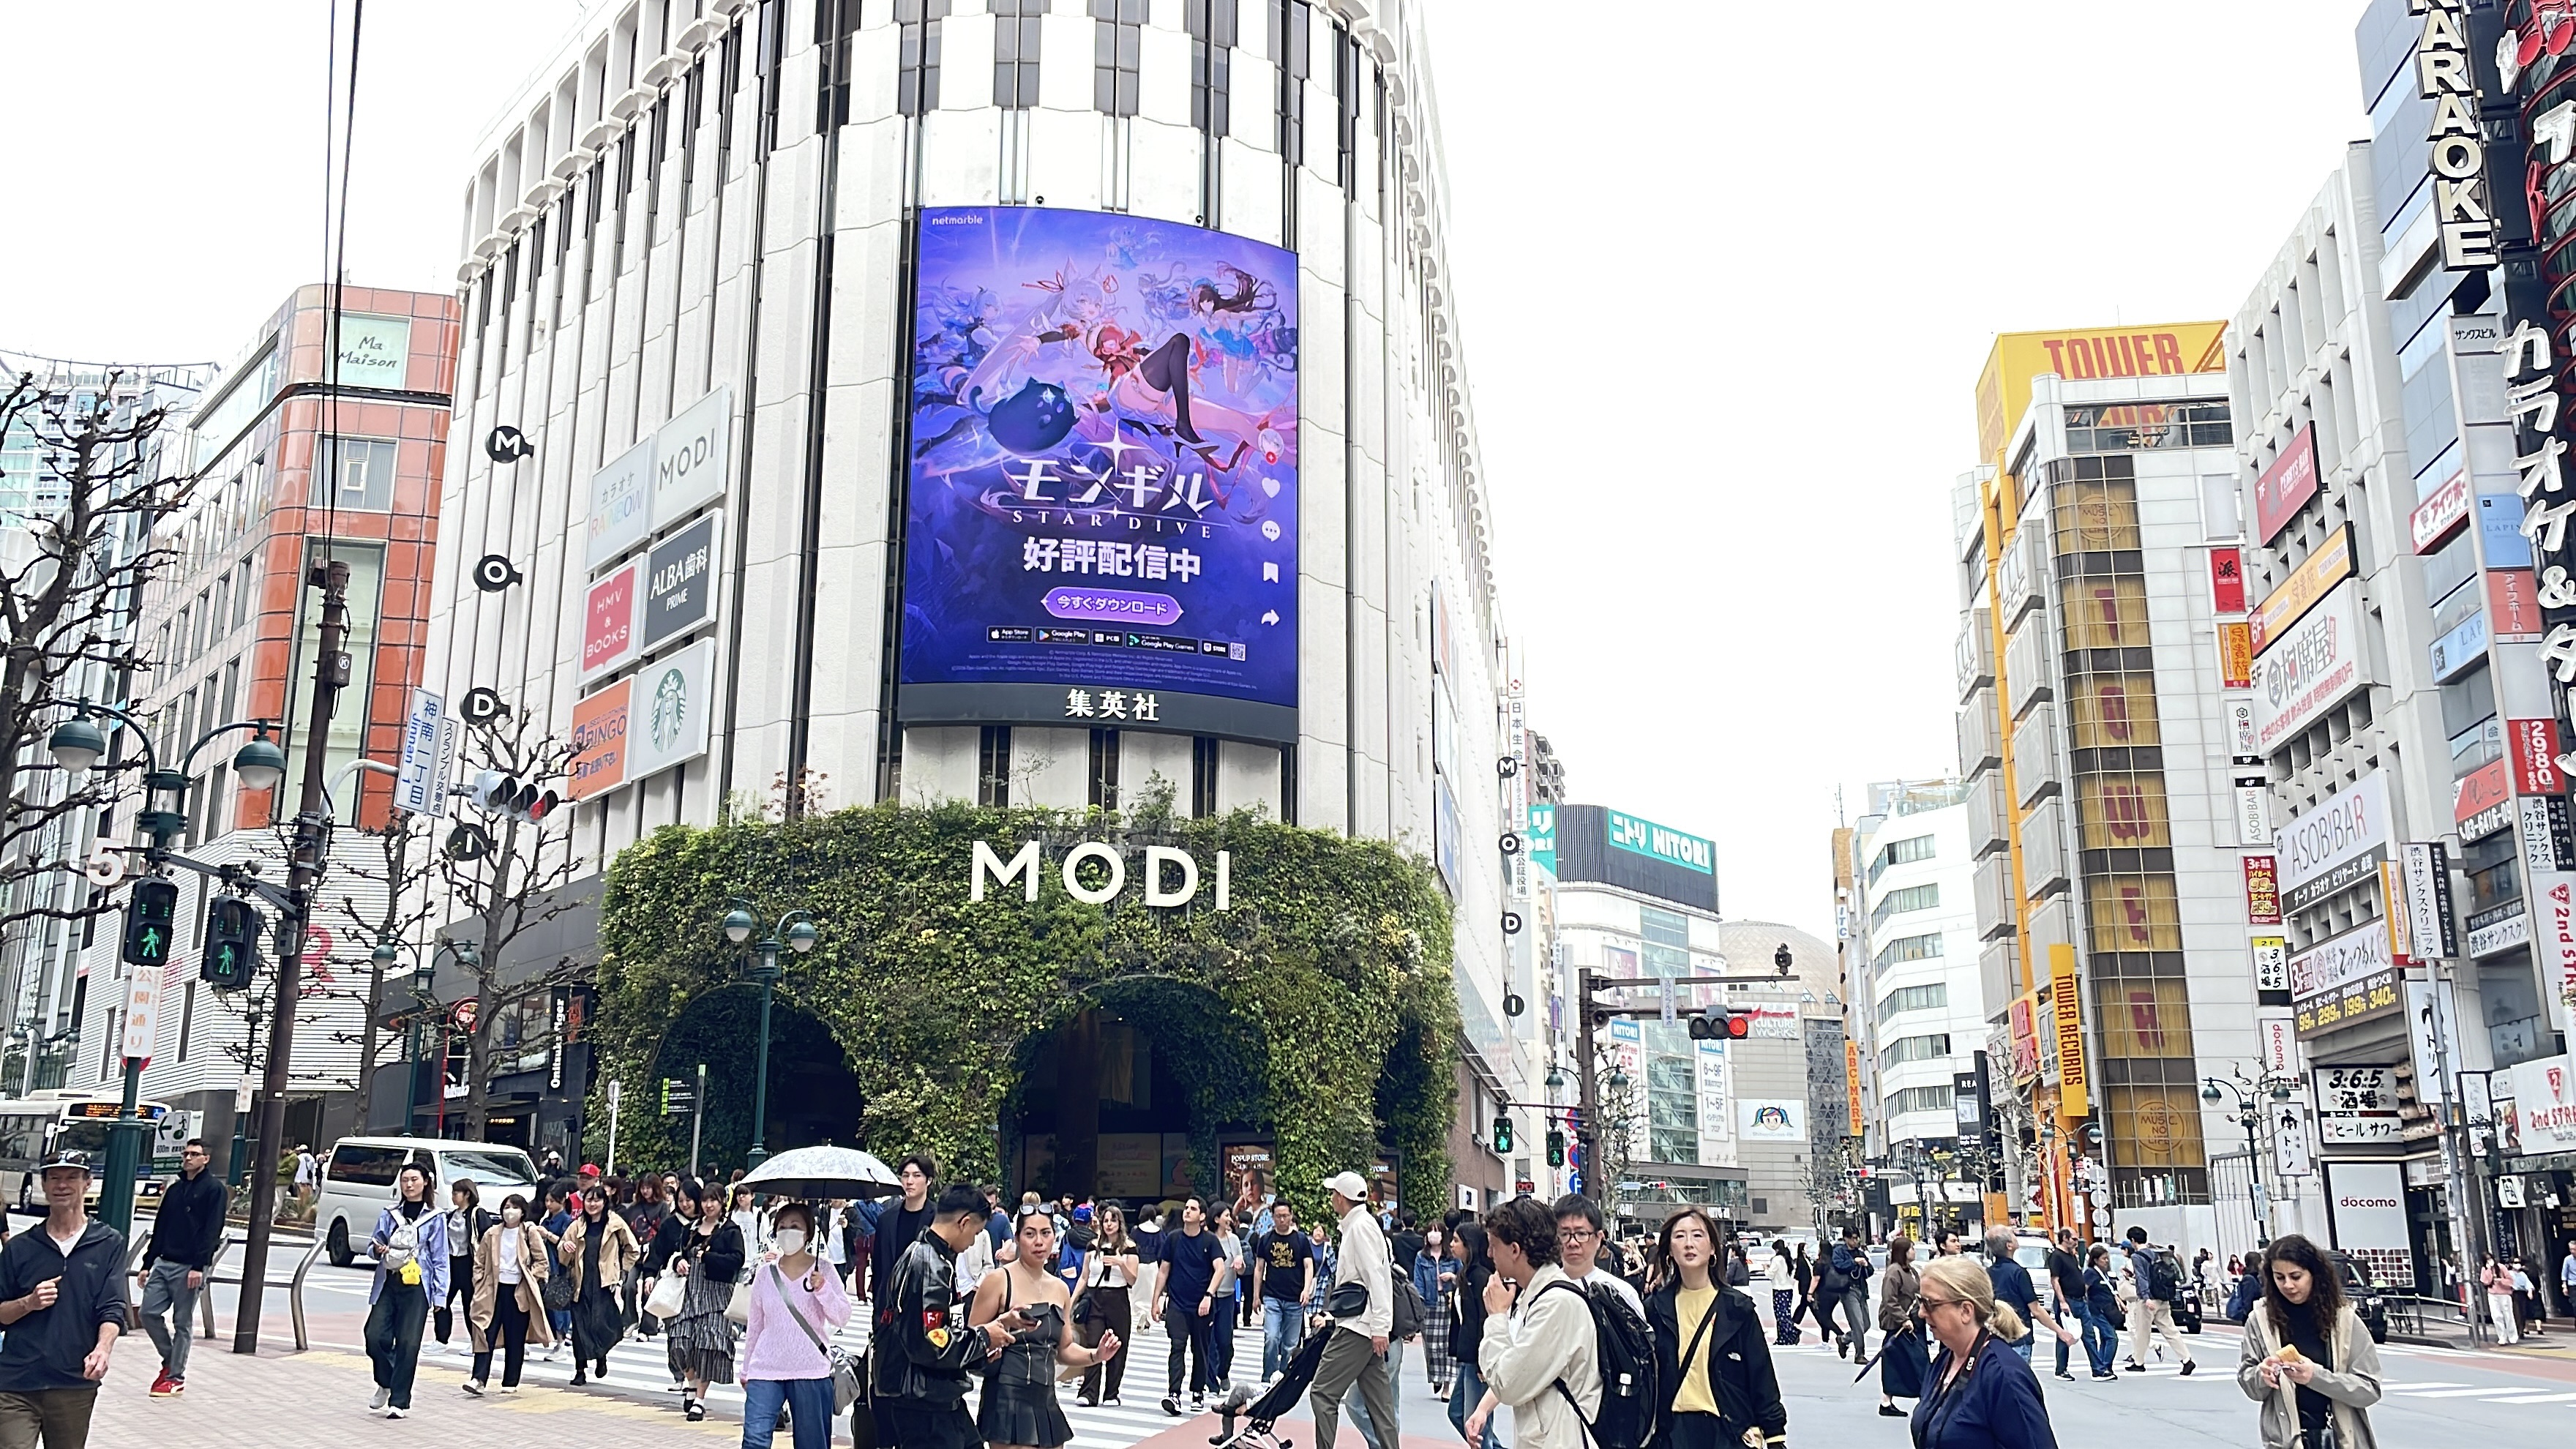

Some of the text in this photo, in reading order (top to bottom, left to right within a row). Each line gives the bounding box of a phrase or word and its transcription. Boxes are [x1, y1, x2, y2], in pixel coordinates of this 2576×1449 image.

[932, 214, 983, 226] netmarble
[359, 336, 383, 350] Ma
[2455, 329, 2496, 340] サンクスビル
[338, 351, 397, 368] Maison
[2043, 334, 2184, 380] TOWER
[660, 428, 716, 491] MODI
[602, 471, 634, 504] カラオケ
[1014, 458, 1213, 521] モンギル
[591, 487, 644, 540] RAINBOW
[1013, 510, 1212, 539] STAR DIVE
[650, 545, 708, 601] ALBA歯科
[1024, 536, 1201, 583] 好評配信中
[596, 588, 623, 614] HMV
[665, 588, 688, 613] PRIME
[1057, 595, 1168, 617] 今すぐダウンロード
[587, 624, 627, 656] BOOKS
[1002, 629, 1013, 637] App
[1052, 630, 1086, 640] Google Play
[1142, 640, 1161, 648] Google
[1162, 642, 1174, 651] Play
[2252, 617, 2262, 644] 6F
[2252, 664, 2262, 689] 5F
[1065, 689, 1160, 722] 集英社
[405, 713, 421, 764] Jinnan
[1512, 703, 1524, 761] 日本生命
[410, 699, 438, 806] 神南一丁目
[433, 722, 452, 813] スクランブル交差点
[1611, 814, 1647, 850] ニトリ
[2246, 790, 2262, 842] ASOBIBAR
[2532, 798, 2551, 863] 渋谷サンクス
[1652, 827, 1711, 869] NITORI
[2292, 794, 2367, 877] ASOBIBAR
[2523, 811, 2538, 863] クリニック
[970, 840, 1230, 911] MODI
[2410, 845, 2433, 956] 渋谷サンクスクリニック
[1839, 907, 1847, 937] ITC
[2556, 907, 2574, 943] 2nd
[130, 969, 152, 1049] 公園通り
[1755, 1018, 1796, 1029] CULTURE
[1614, 1024, 1637, 1038] NITORI
[1756, 1028, 1797, 1038] WORKS
[2054, 973, 2083, 1086] TOWER RECORDS
[2272, 1023, 2284, 1070] docomo
[1847, 1046, 1860, 1128] ABC-MART
[2340, 1090, 2378, 1109] 酒場
[2152, 1126, 2166, 1134] NO
[2531, 1109, 2549, 1128] 2nd
[1231, 1153, 1270, 1163] POPUP STORE
[2284, 1135, 2294, 1169] トリノ
[2340, 1197, 2397, 1208] docomo
